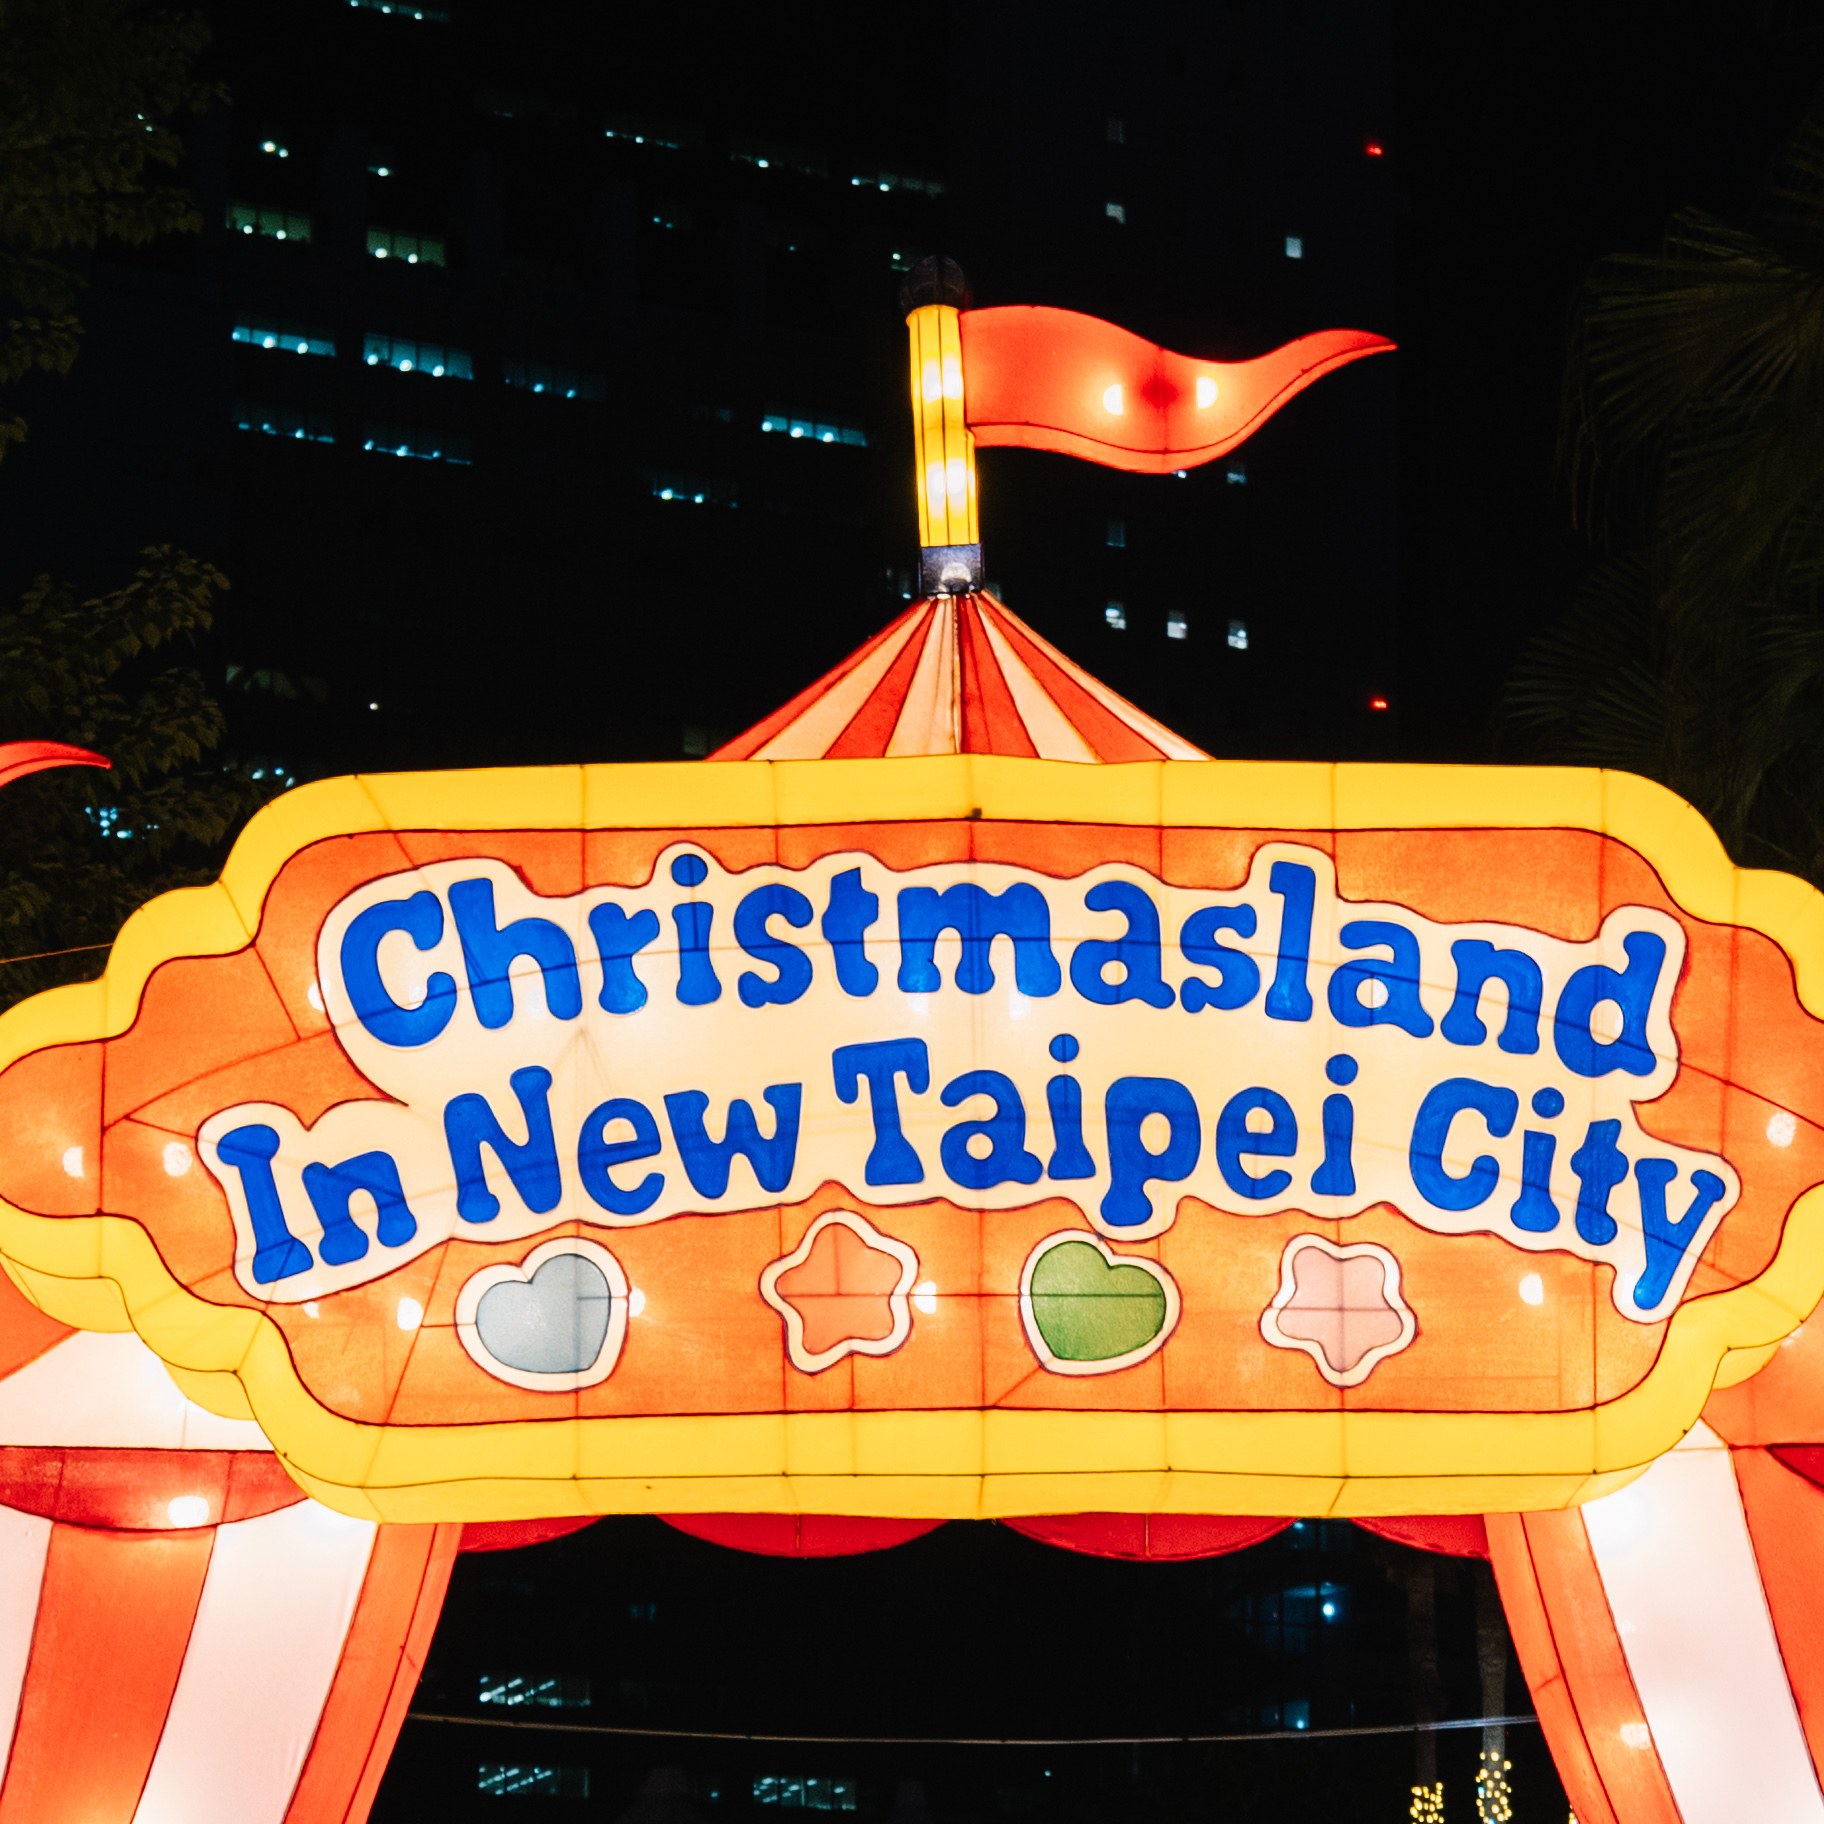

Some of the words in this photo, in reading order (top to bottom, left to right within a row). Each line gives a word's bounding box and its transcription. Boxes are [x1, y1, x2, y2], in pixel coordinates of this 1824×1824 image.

[341, 855, 1665, 1077] Christmasland
[213, 1122, 417, 1285] In
[444, 1065, 802, 1224] New
[832, 1034, 1357, 1227] Taipei
[1409, 1077, 1728, 1310] City
